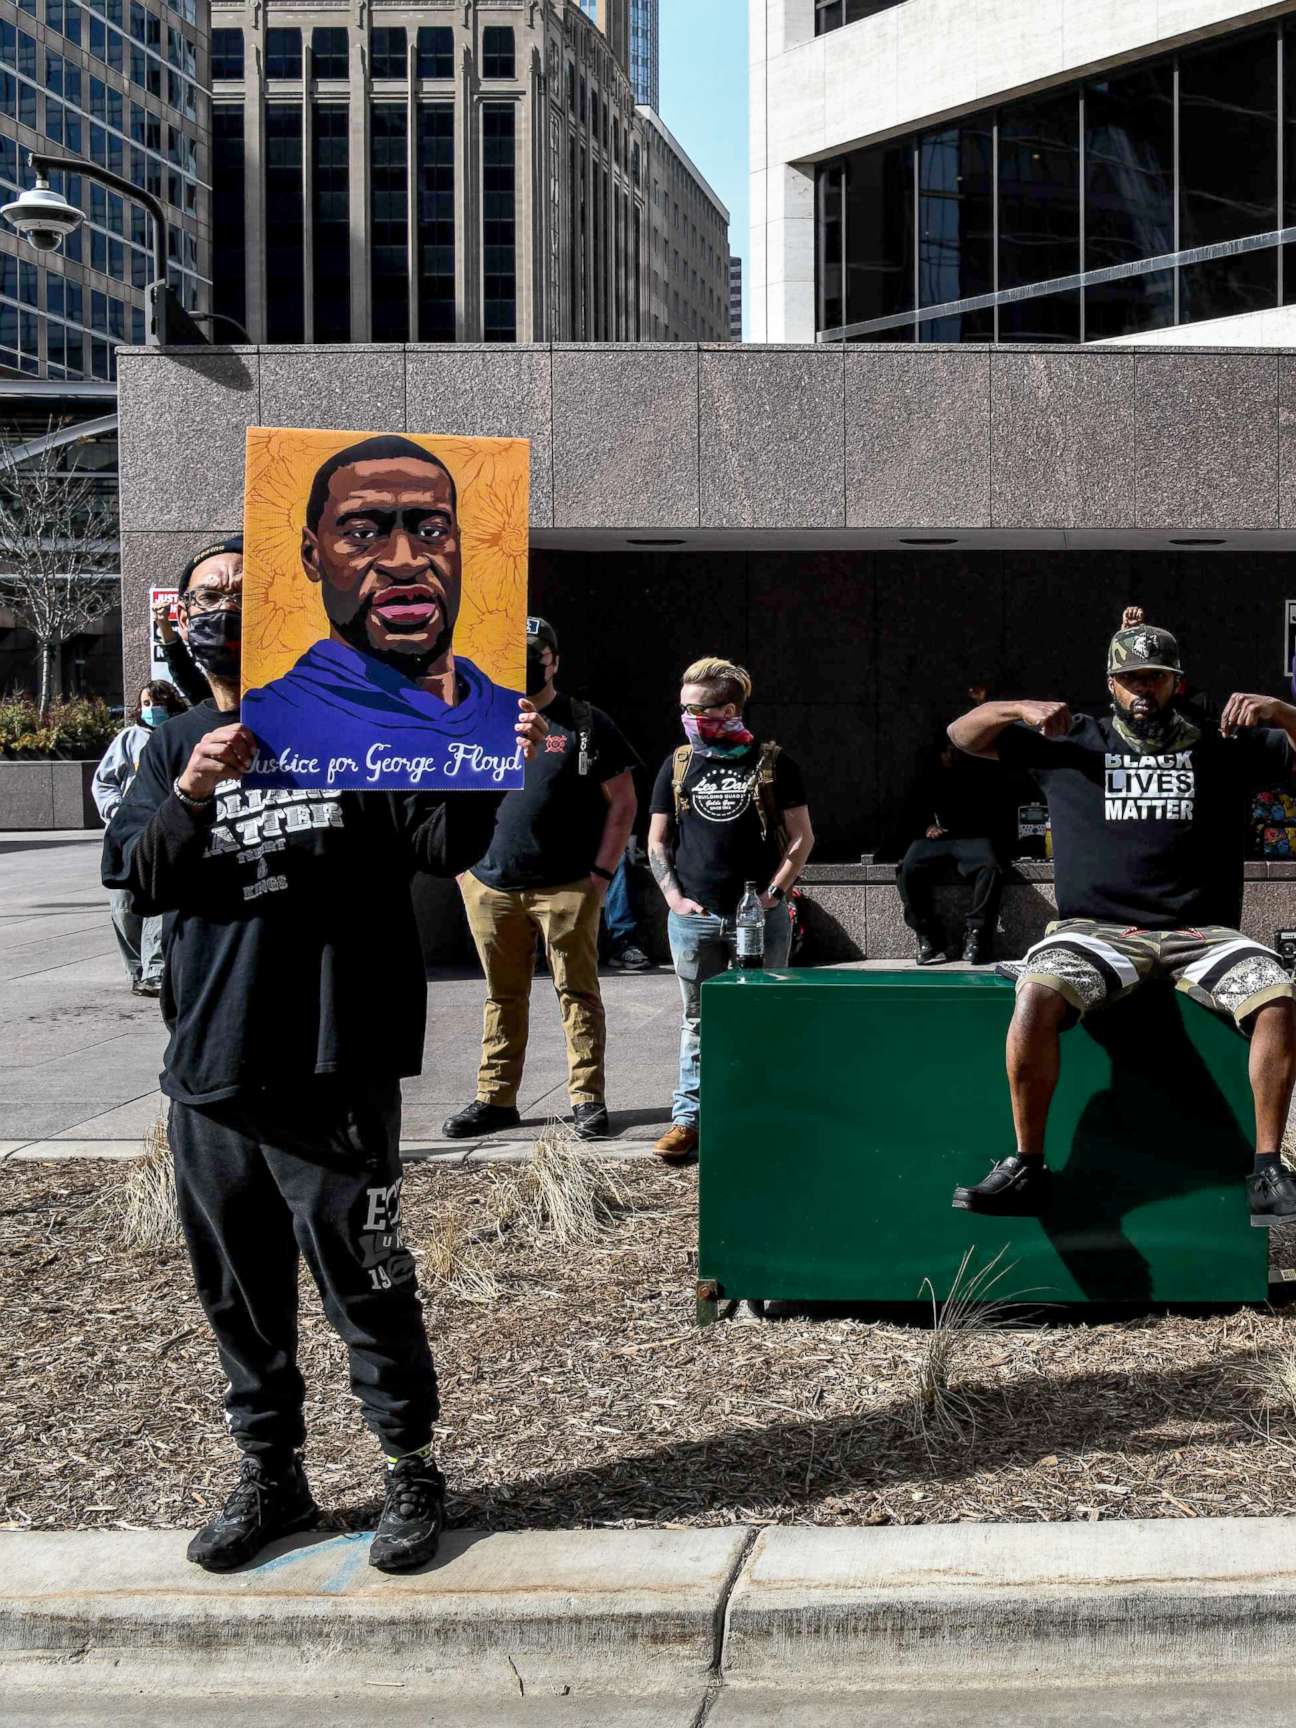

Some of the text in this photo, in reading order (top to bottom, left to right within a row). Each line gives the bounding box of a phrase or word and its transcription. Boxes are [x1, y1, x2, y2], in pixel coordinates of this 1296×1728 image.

[327, 758, 359, 783] for
[365, 743, 436, 783] George
[444, 742, 522, 782] Floyd
[1105, 751, 1193, 769] BLACK
[1107, 772, 1193, 794] LIVES
[1105, 799, 1194, 820] MATTER
[202, 801, 345, 858] ATTER
